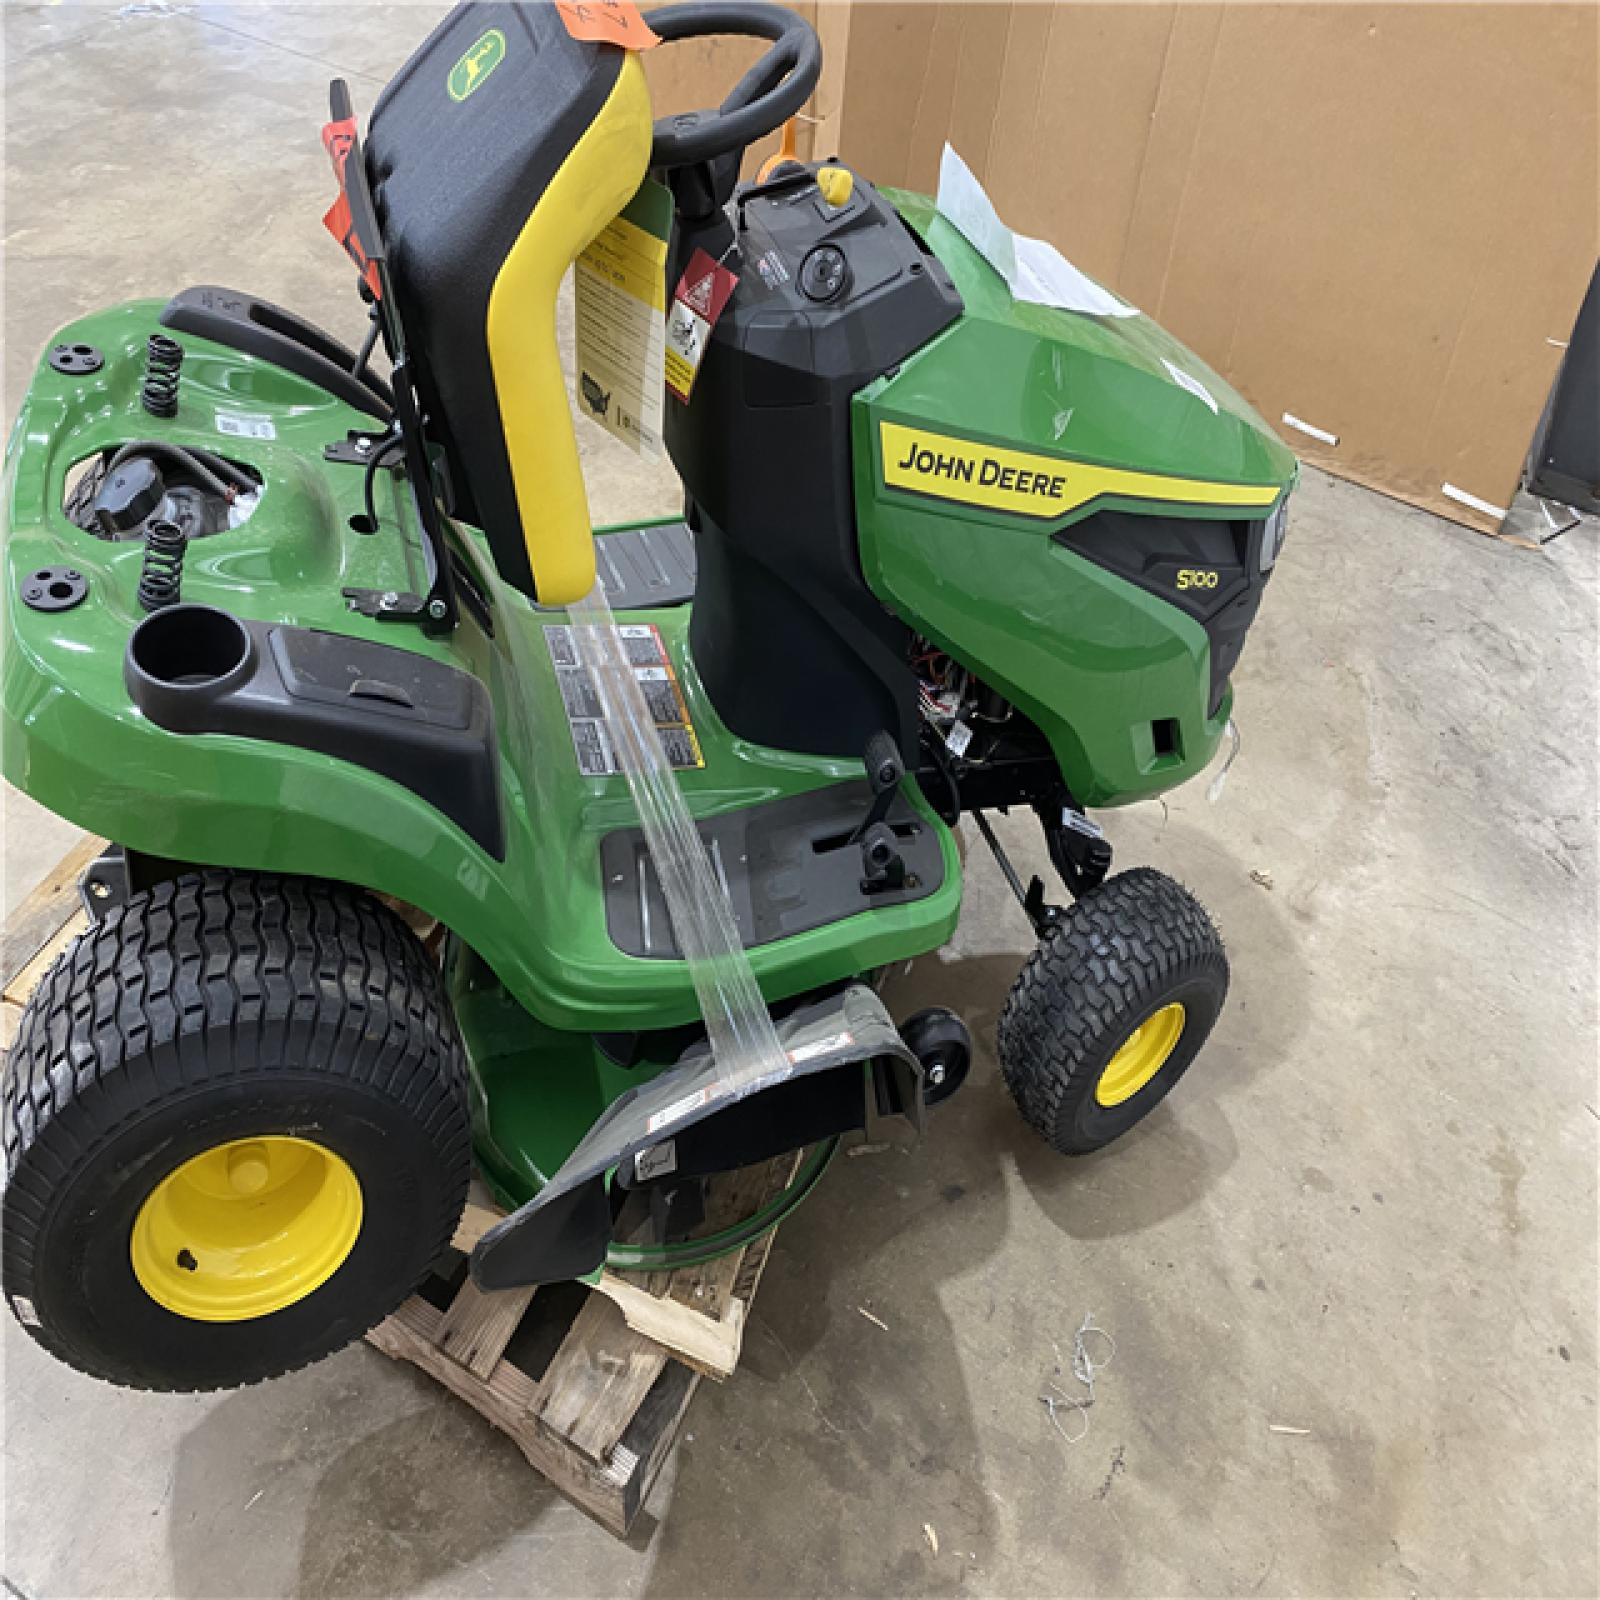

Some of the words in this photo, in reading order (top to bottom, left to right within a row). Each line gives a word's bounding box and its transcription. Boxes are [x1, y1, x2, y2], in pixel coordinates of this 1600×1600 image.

[898, 442, 975, 483] JOHN
[978, 457, 1066, 498] DEERE
[1176, 569, 1218, 590] S100
